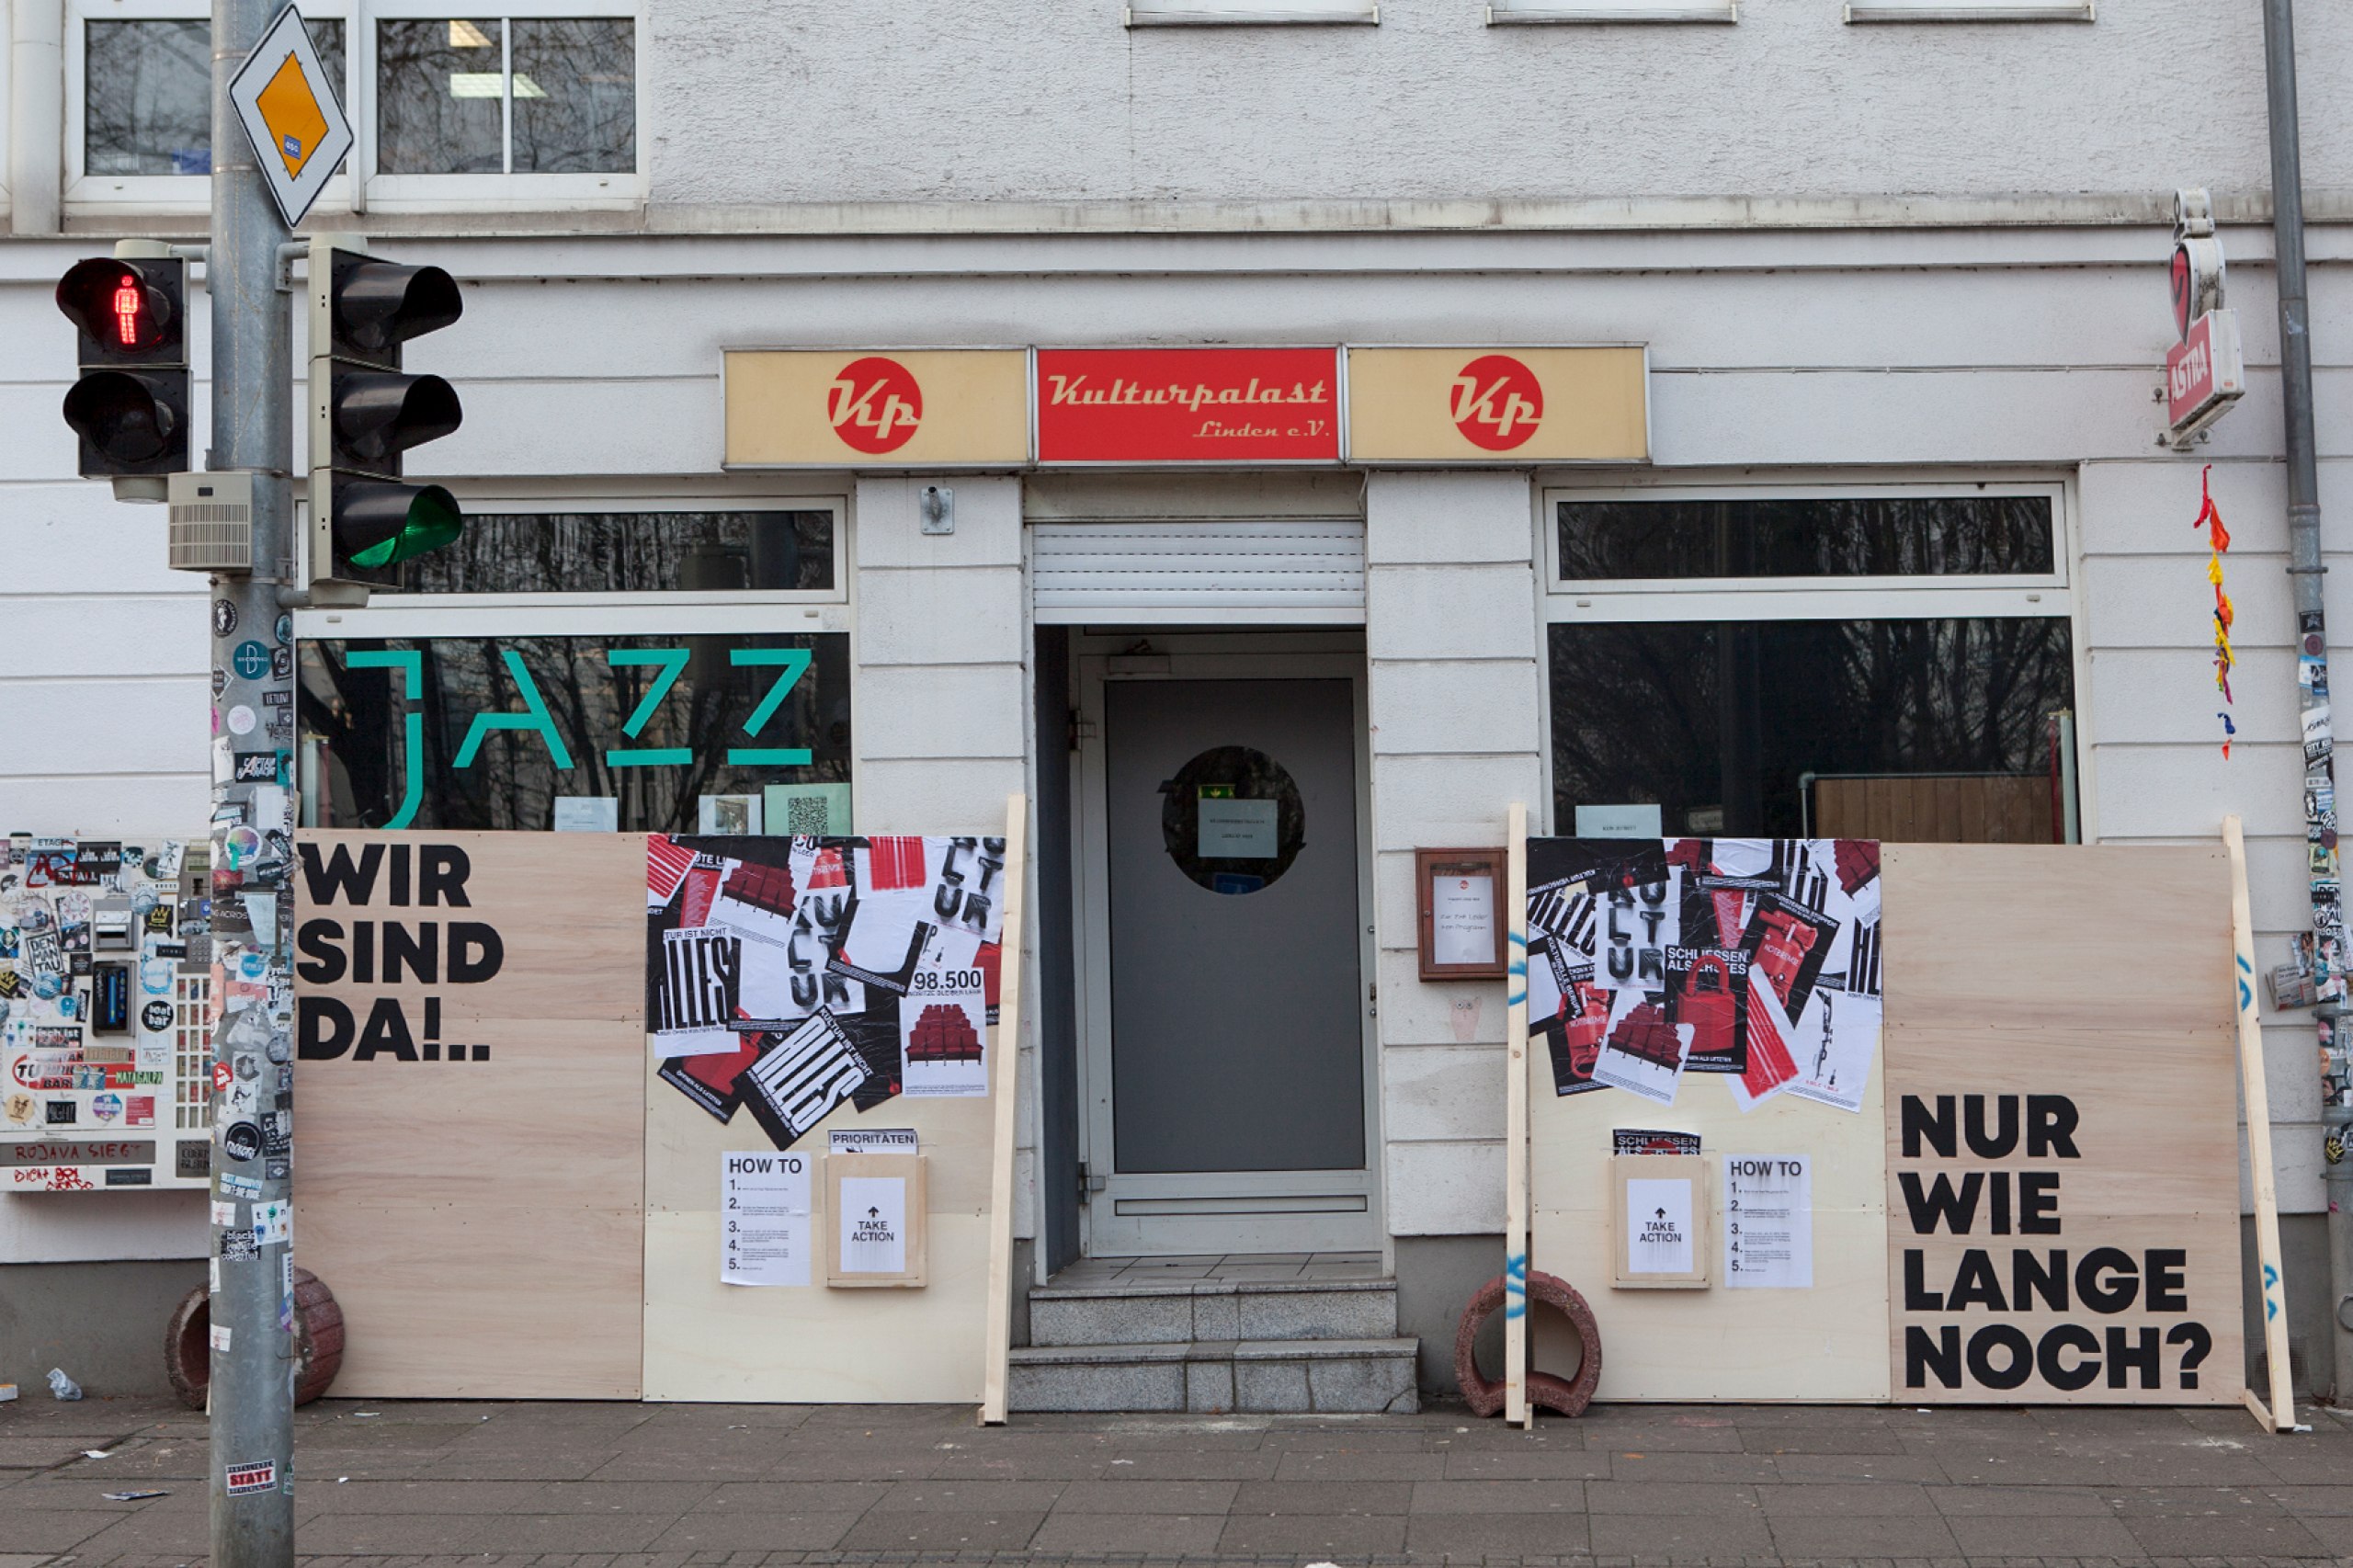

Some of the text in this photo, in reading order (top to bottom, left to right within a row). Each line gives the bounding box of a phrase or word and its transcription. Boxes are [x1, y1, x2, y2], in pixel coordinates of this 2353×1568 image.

[2171, 341, 2209, 404] ASTRA
[1048, 375, 1328, 412] Kulturpalast
[1192, 420, 1330, 437] Linden e.V.
[347, 648, 813, 830] JAZZ
[296, 842, 472, 908] WIR
[685, 930, 698, 938] IST
[700, 927, 727, 937] NICHT
[296, 918, 505, 984] SIND
[914, 970, 982, 990] 98.500
[818, 1007, 847, 1040] KULTUR
[851, 1051, 874, 1076] NICHT
[752, 1014, 866, 1133] ALLES
[1901, 1094, 2082, 1159] NUR
[832, 1131, 915, 1144] PRIORITÄTEN
[15, 1145, 80, 1161] ROJAVA
[729, 1158, 802, 1175] HOW TO
[1731, 1161, 1802, 1176] HOW TO
[729, 1179, 741, 1190] 1.
[1731, 1181, 1743, 1194] 1.
[729, 1197, 741, 1210] 2.
[1731, 1199, 1743, 1211] 2.
[1897, 1172, 2061, 1234] WIE
[729, 1221, 741, 1233] 3.
[858, 1221, 888, 1231] TAKE
[1645, 1221, 1676, 1232] TAKE
[1731, 1222, 1743, 1234] 3.
[851, 1232, 894, 1242] ACTION
[1639, 1233, 1682, 1243] ACTION
[729, 1240, 741, 1251] 4.
[1731, 1241, 1743, 1253] 4.
[729, 1257, 741, 1270] 5.
[1731, 1259, 1744, 1271] 5.
[1904, 1246, 2188, 1314] LANGE
[1905, 1322, 2212, 1392] NOCH?
[230, 1470, 273, 1487] STATT
